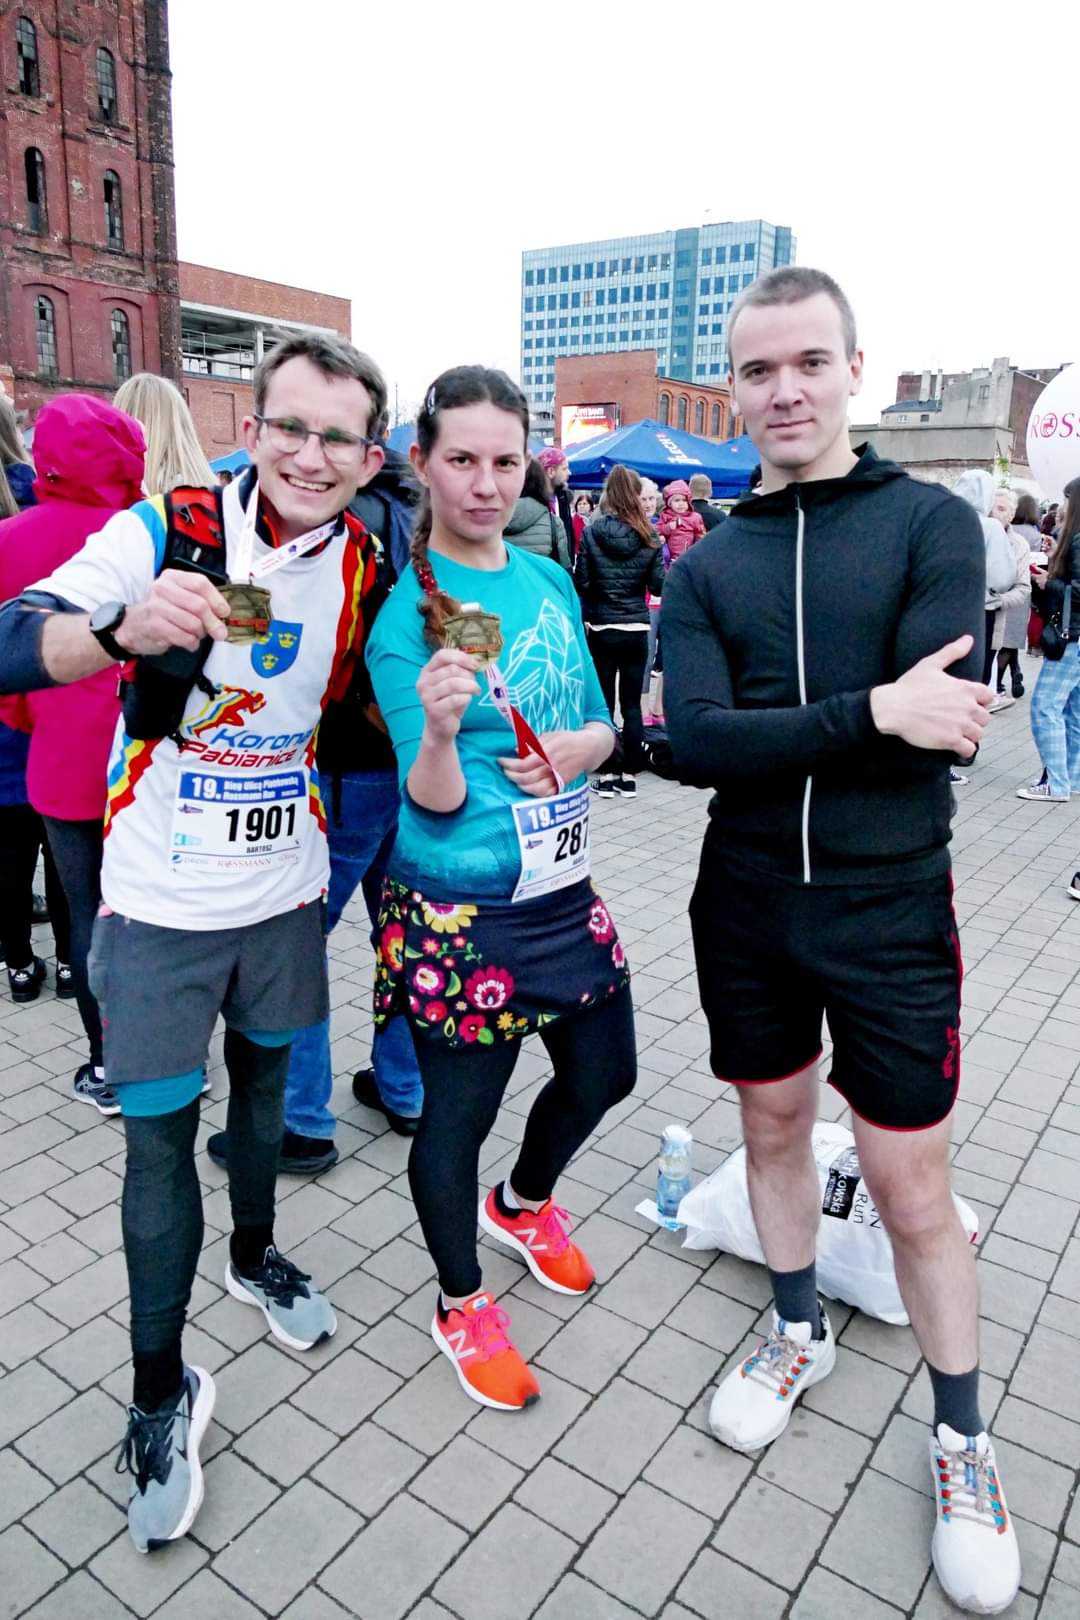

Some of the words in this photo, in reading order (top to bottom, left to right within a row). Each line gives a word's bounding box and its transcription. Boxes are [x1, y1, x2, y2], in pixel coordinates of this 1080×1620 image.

[192, 776, 221, 800] 19.
[225, 803, 296, 842] 1901
[528, 805, 555, 830] 19.
[853, 1192, 868, 1224] Run
